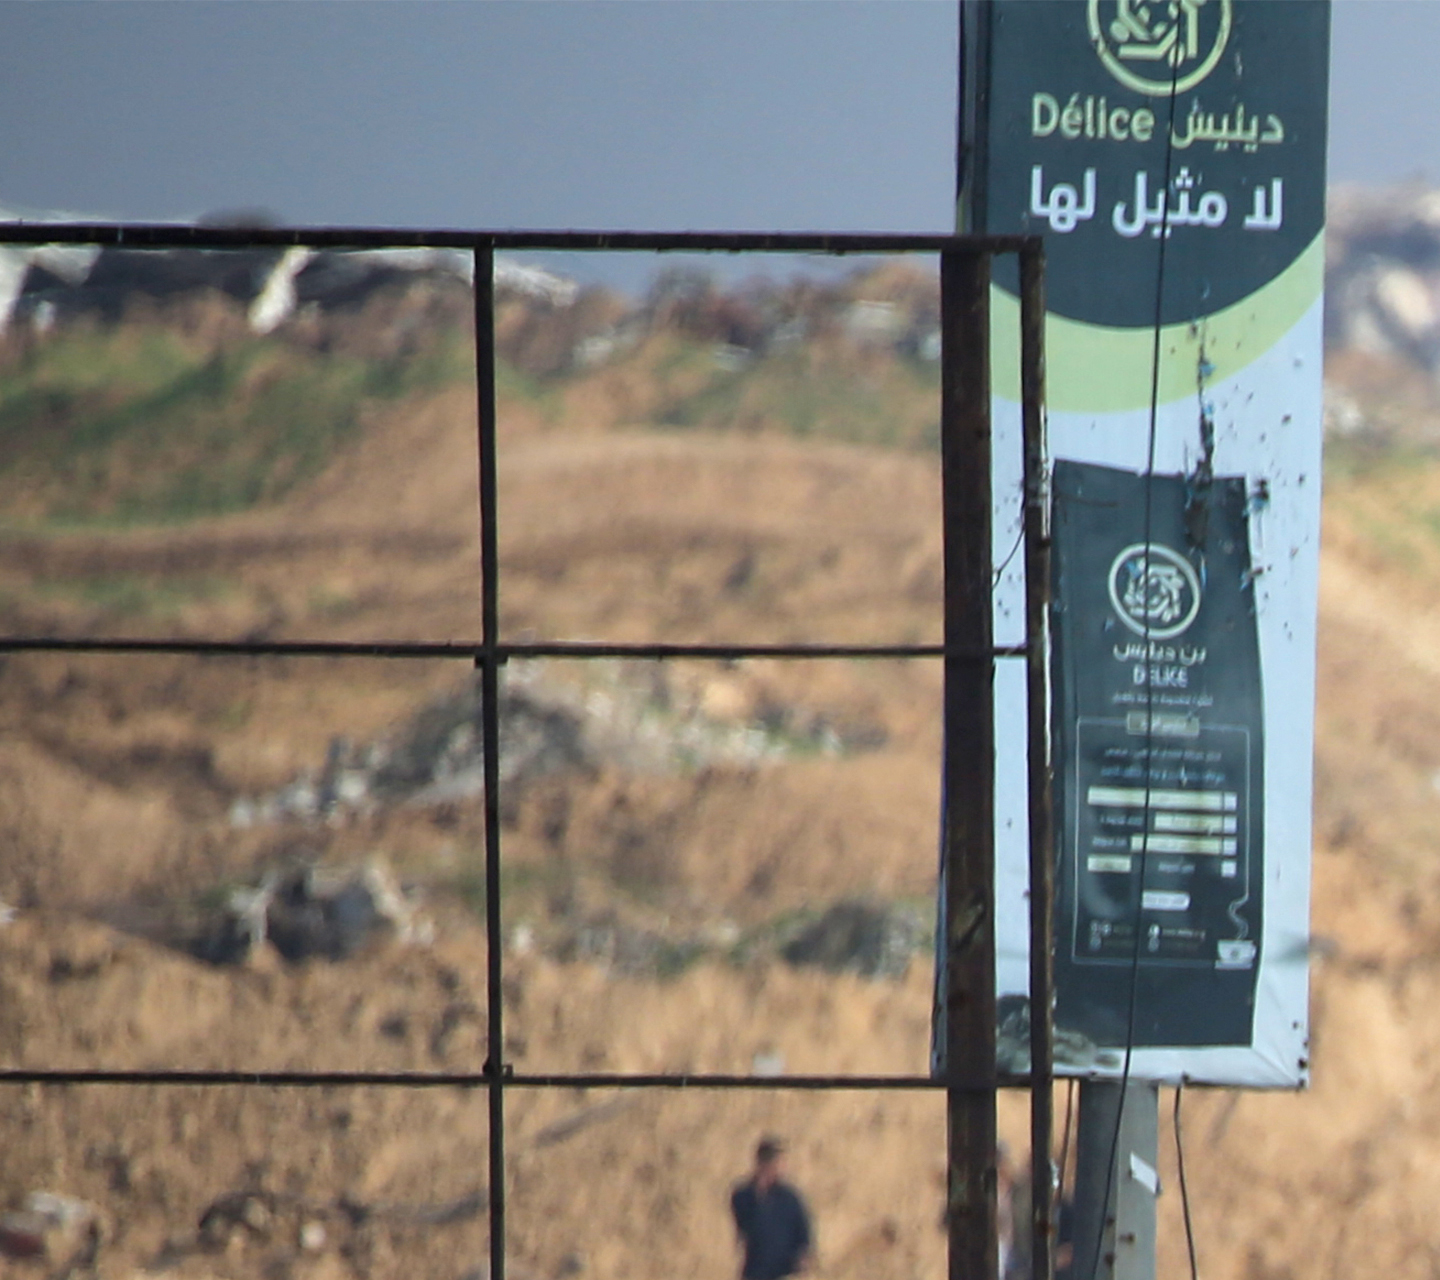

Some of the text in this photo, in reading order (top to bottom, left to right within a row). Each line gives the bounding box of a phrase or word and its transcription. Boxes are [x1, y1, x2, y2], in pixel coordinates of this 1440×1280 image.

[1032, 92, 1155, 141] Délice
[1030, 164, 1284, 239] لا مثيل لها
